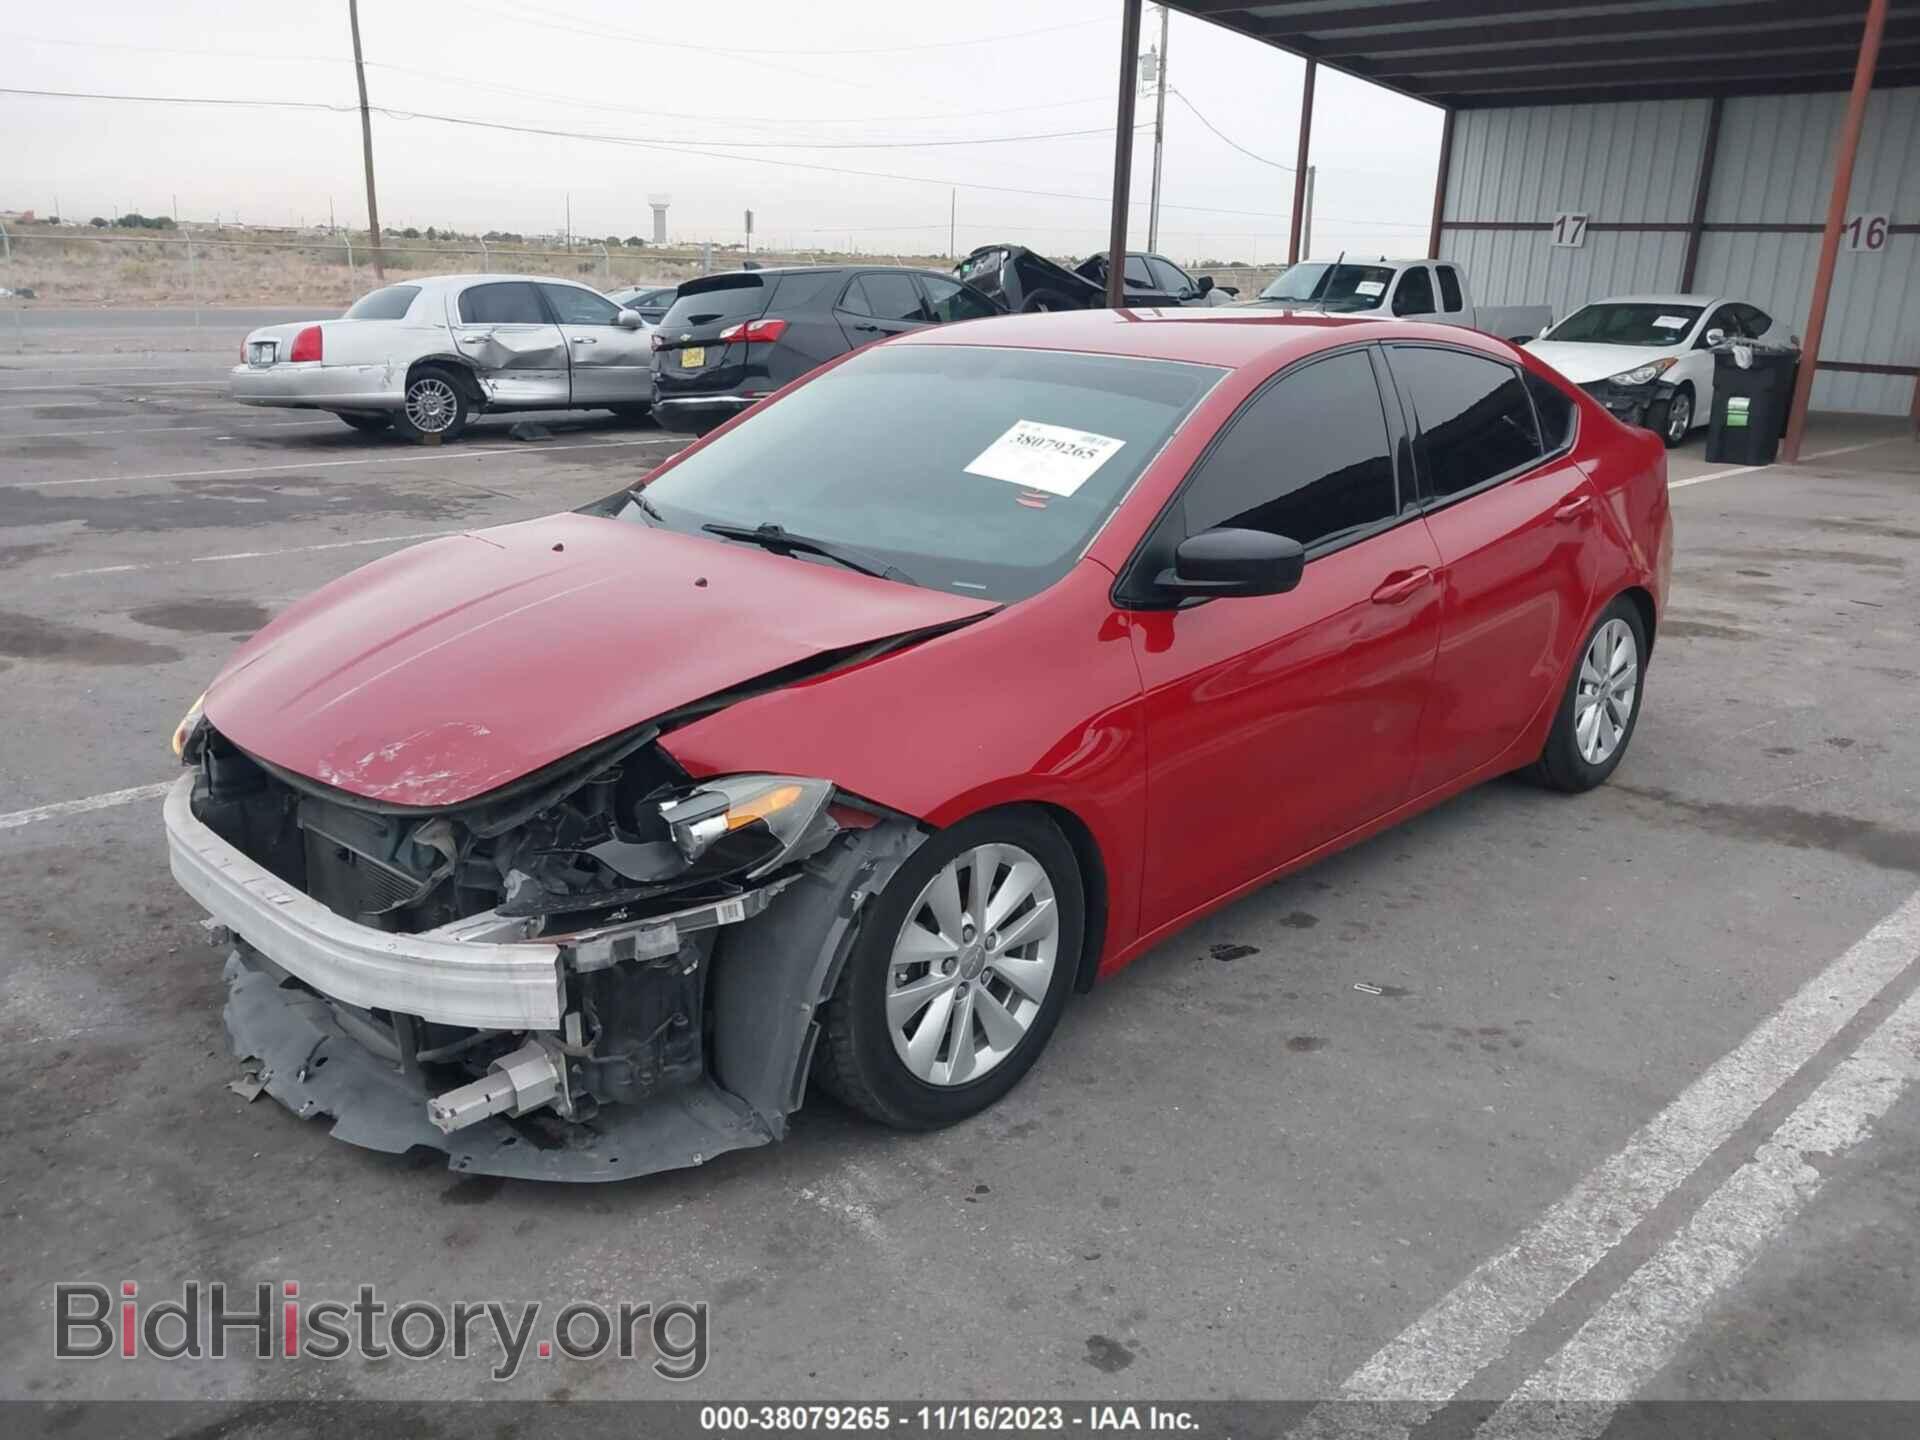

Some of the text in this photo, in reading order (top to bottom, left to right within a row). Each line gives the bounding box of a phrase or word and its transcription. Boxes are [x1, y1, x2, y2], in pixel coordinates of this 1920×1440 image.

[1554, 215, 1586, 244] 17
[1848, 216, 1887, 249] 16
[1010, 433, 1099, 460] 38079265
